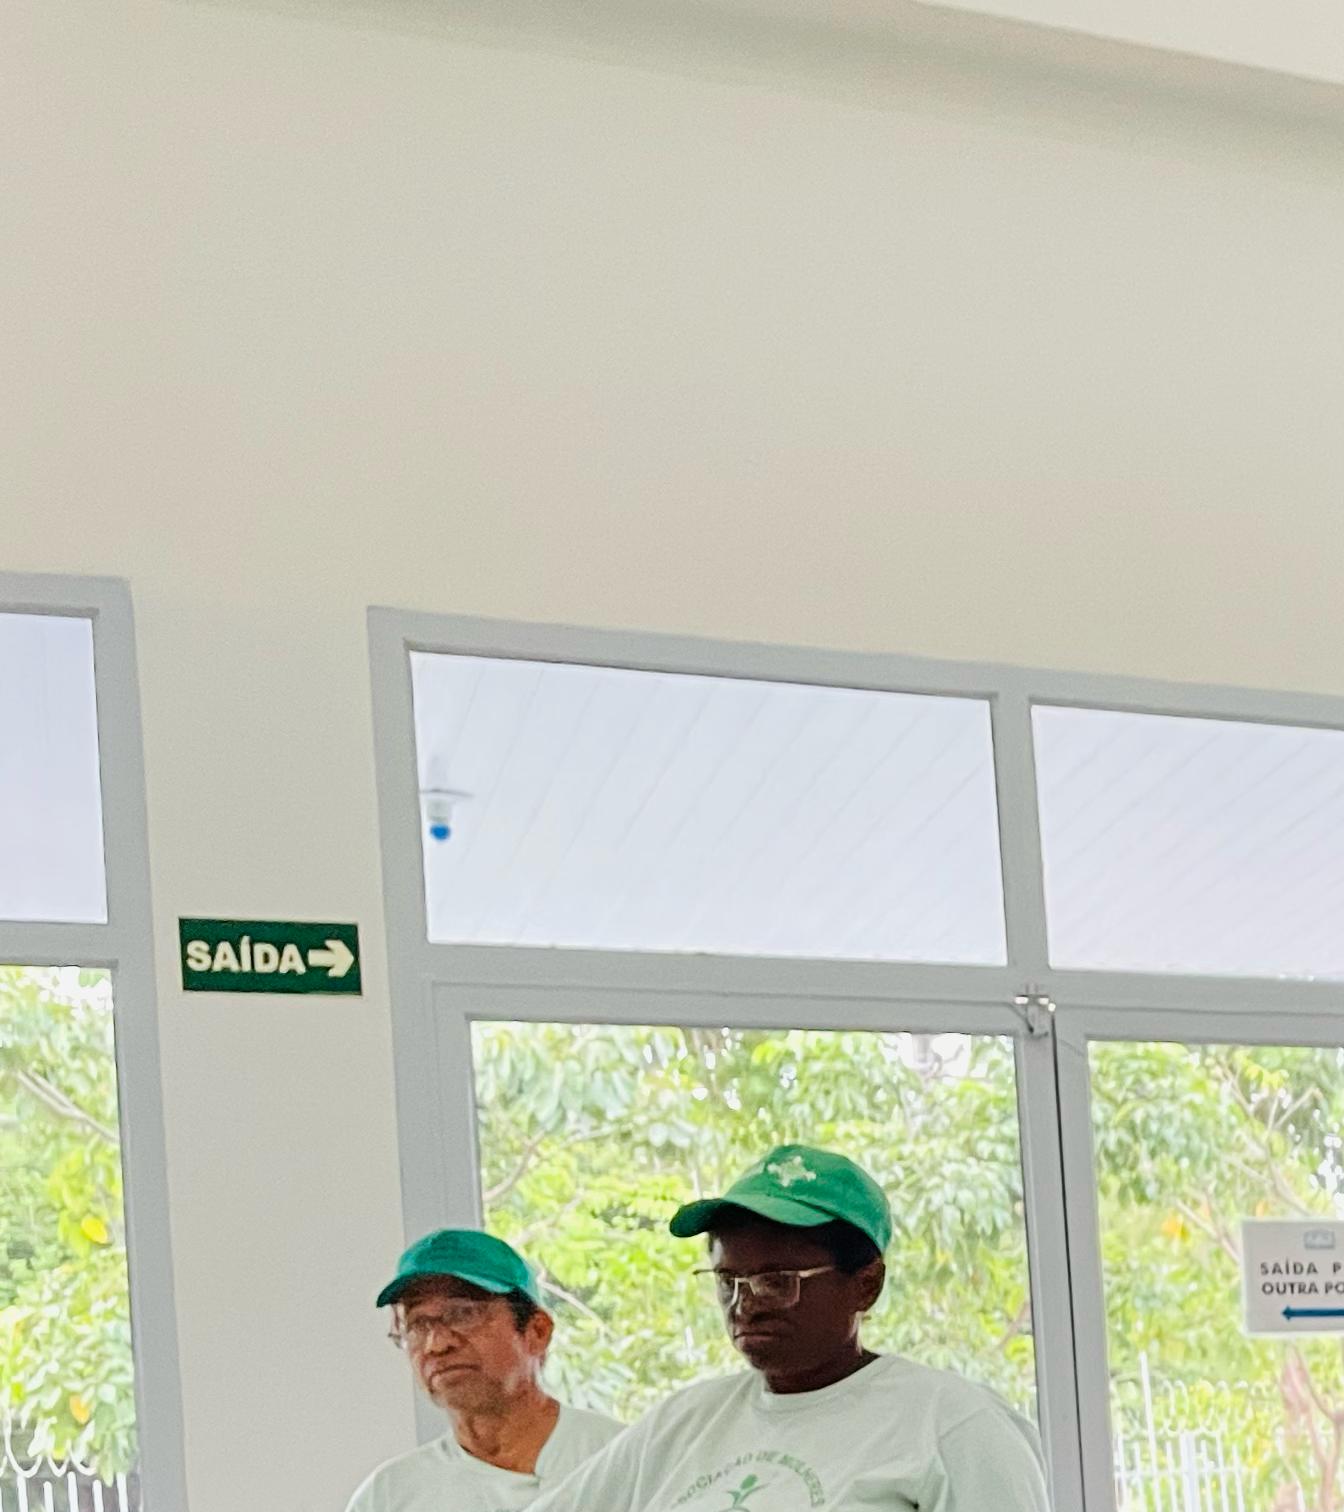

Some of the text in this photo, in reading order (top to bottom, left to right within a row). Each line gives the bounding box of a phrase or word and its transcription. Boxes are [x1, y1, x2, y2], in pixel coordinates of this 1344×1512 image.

[186, 935, 306, 975] SAÍDA
[1260, 1258, 1318, 1275] SAÍDA
[1261, 1282, 1319, 1295] OUTRA
